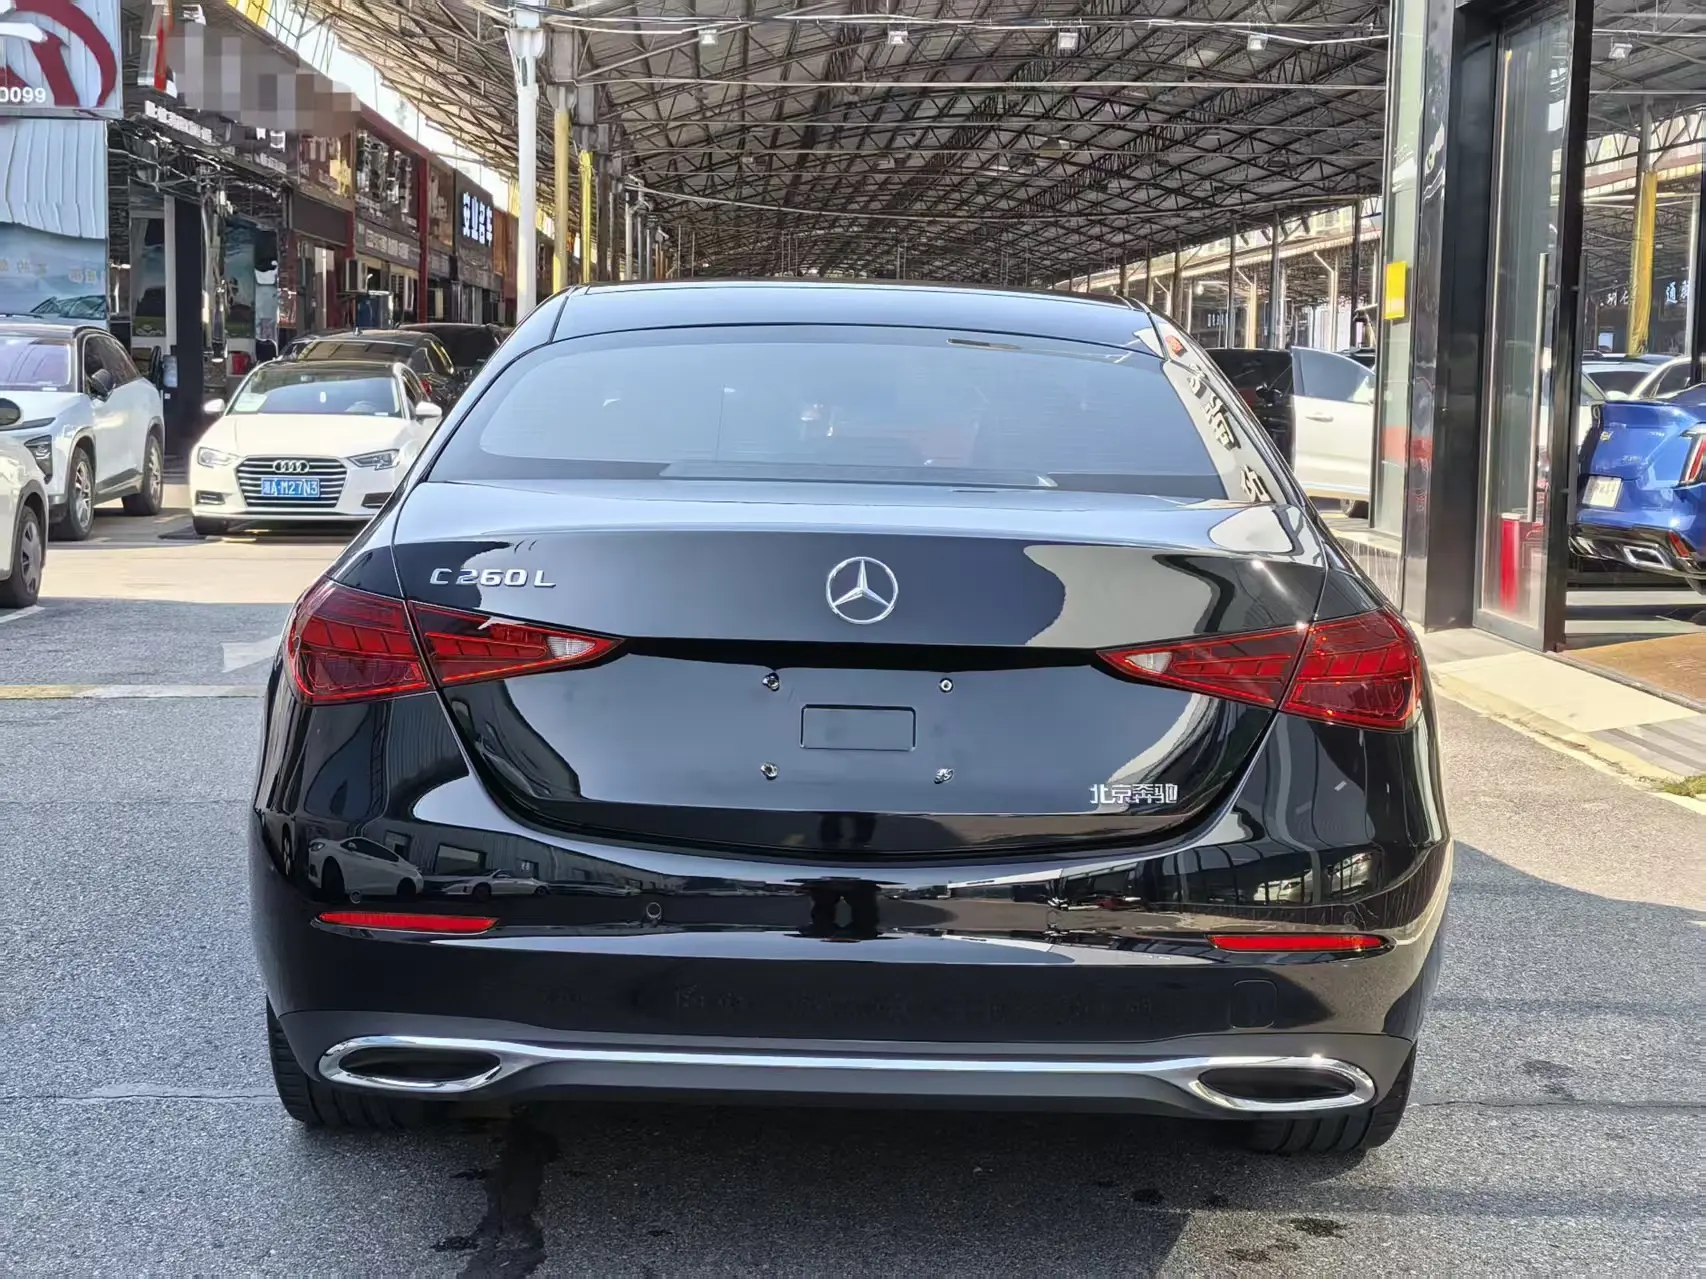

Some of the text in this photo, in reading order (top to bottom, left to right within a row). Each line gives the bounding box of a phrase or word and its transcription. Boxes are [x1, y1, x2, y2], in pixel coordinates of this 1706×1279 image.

[0, 86, 46, 103] 0099
[429, 568, 557, 588] C 260 L
[1089, 783, 1178, 804] 北京奔驰
